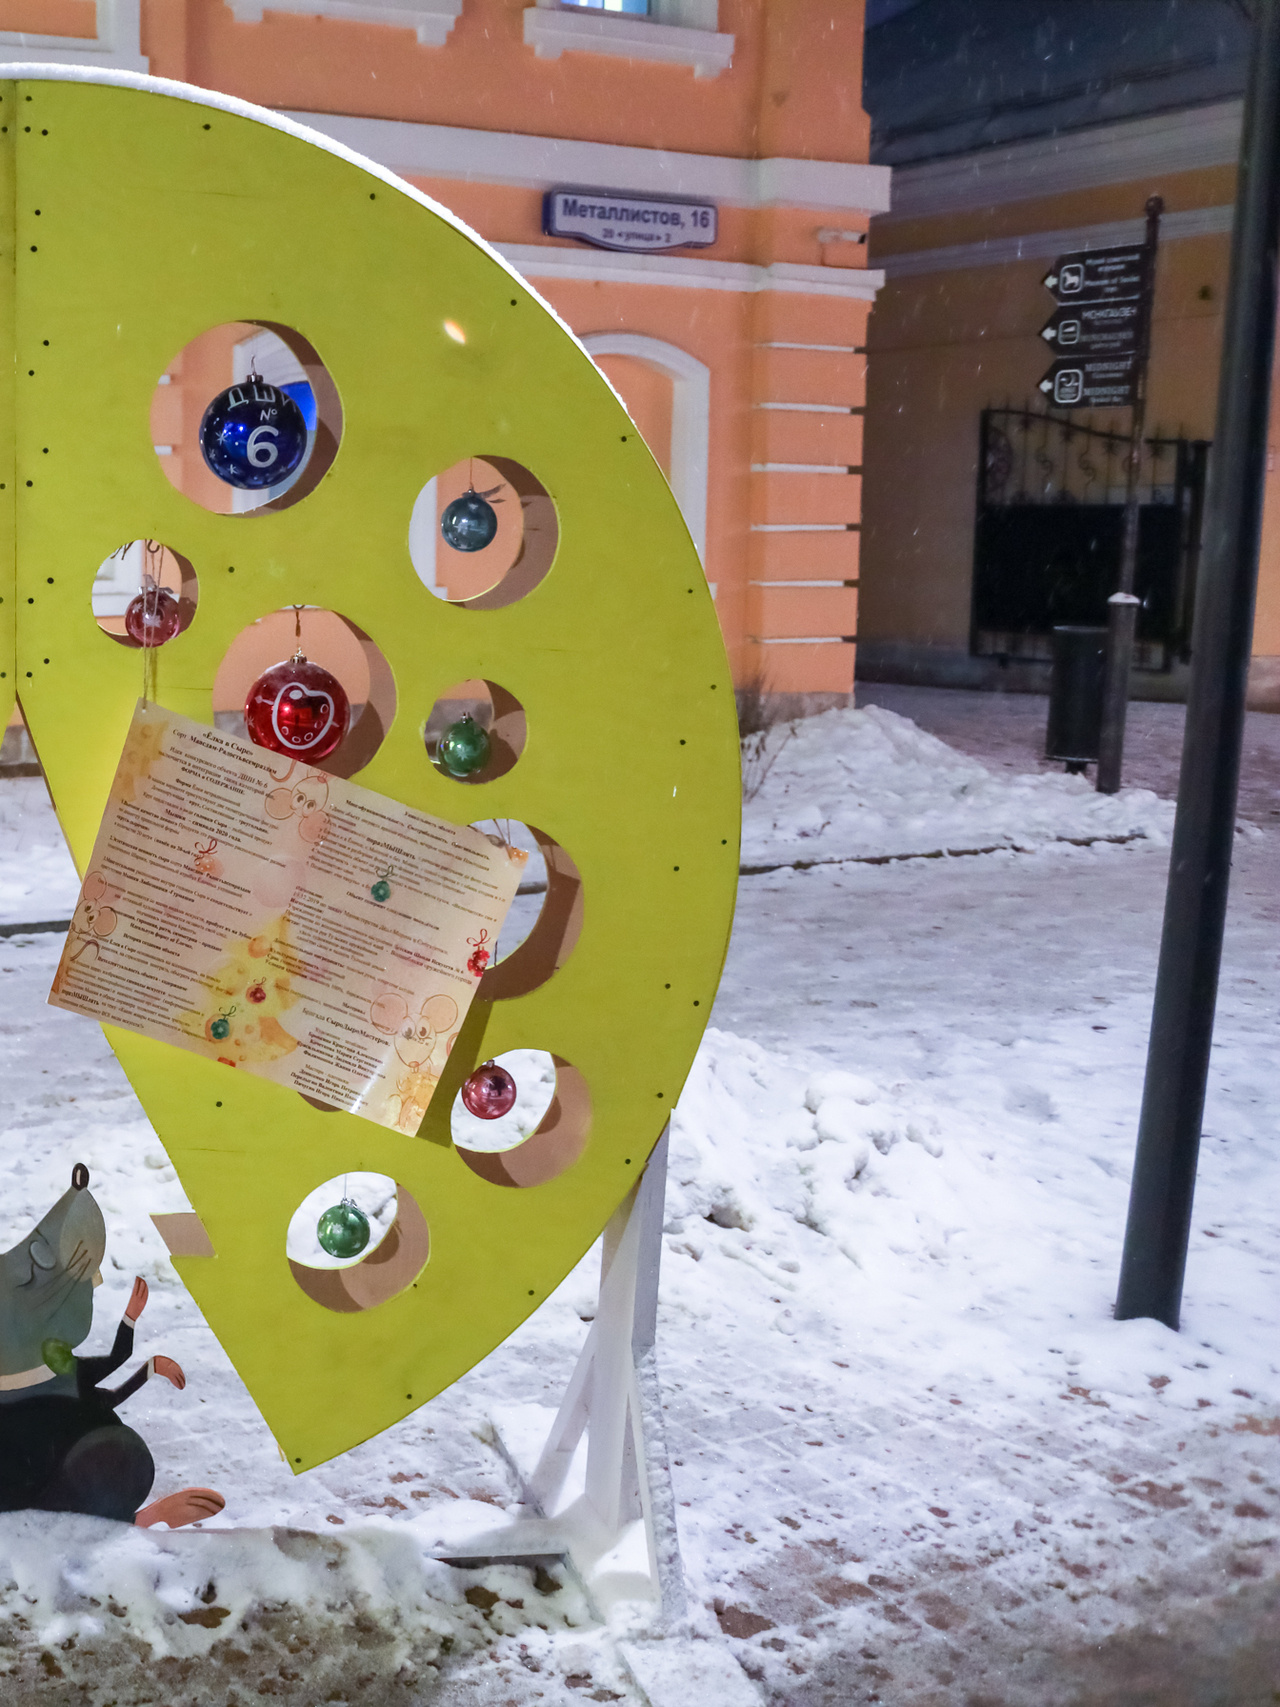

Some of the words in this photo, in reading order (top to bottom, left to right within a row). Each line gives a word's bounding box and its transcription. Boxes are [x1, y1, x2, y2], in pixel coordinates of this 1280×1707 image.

[562, 199, 686, 229] Металлистов,
[690, 209, 710, 229] 16
[246, 425, 279, 468] 6
[215, 828, 228, 836] 2020
